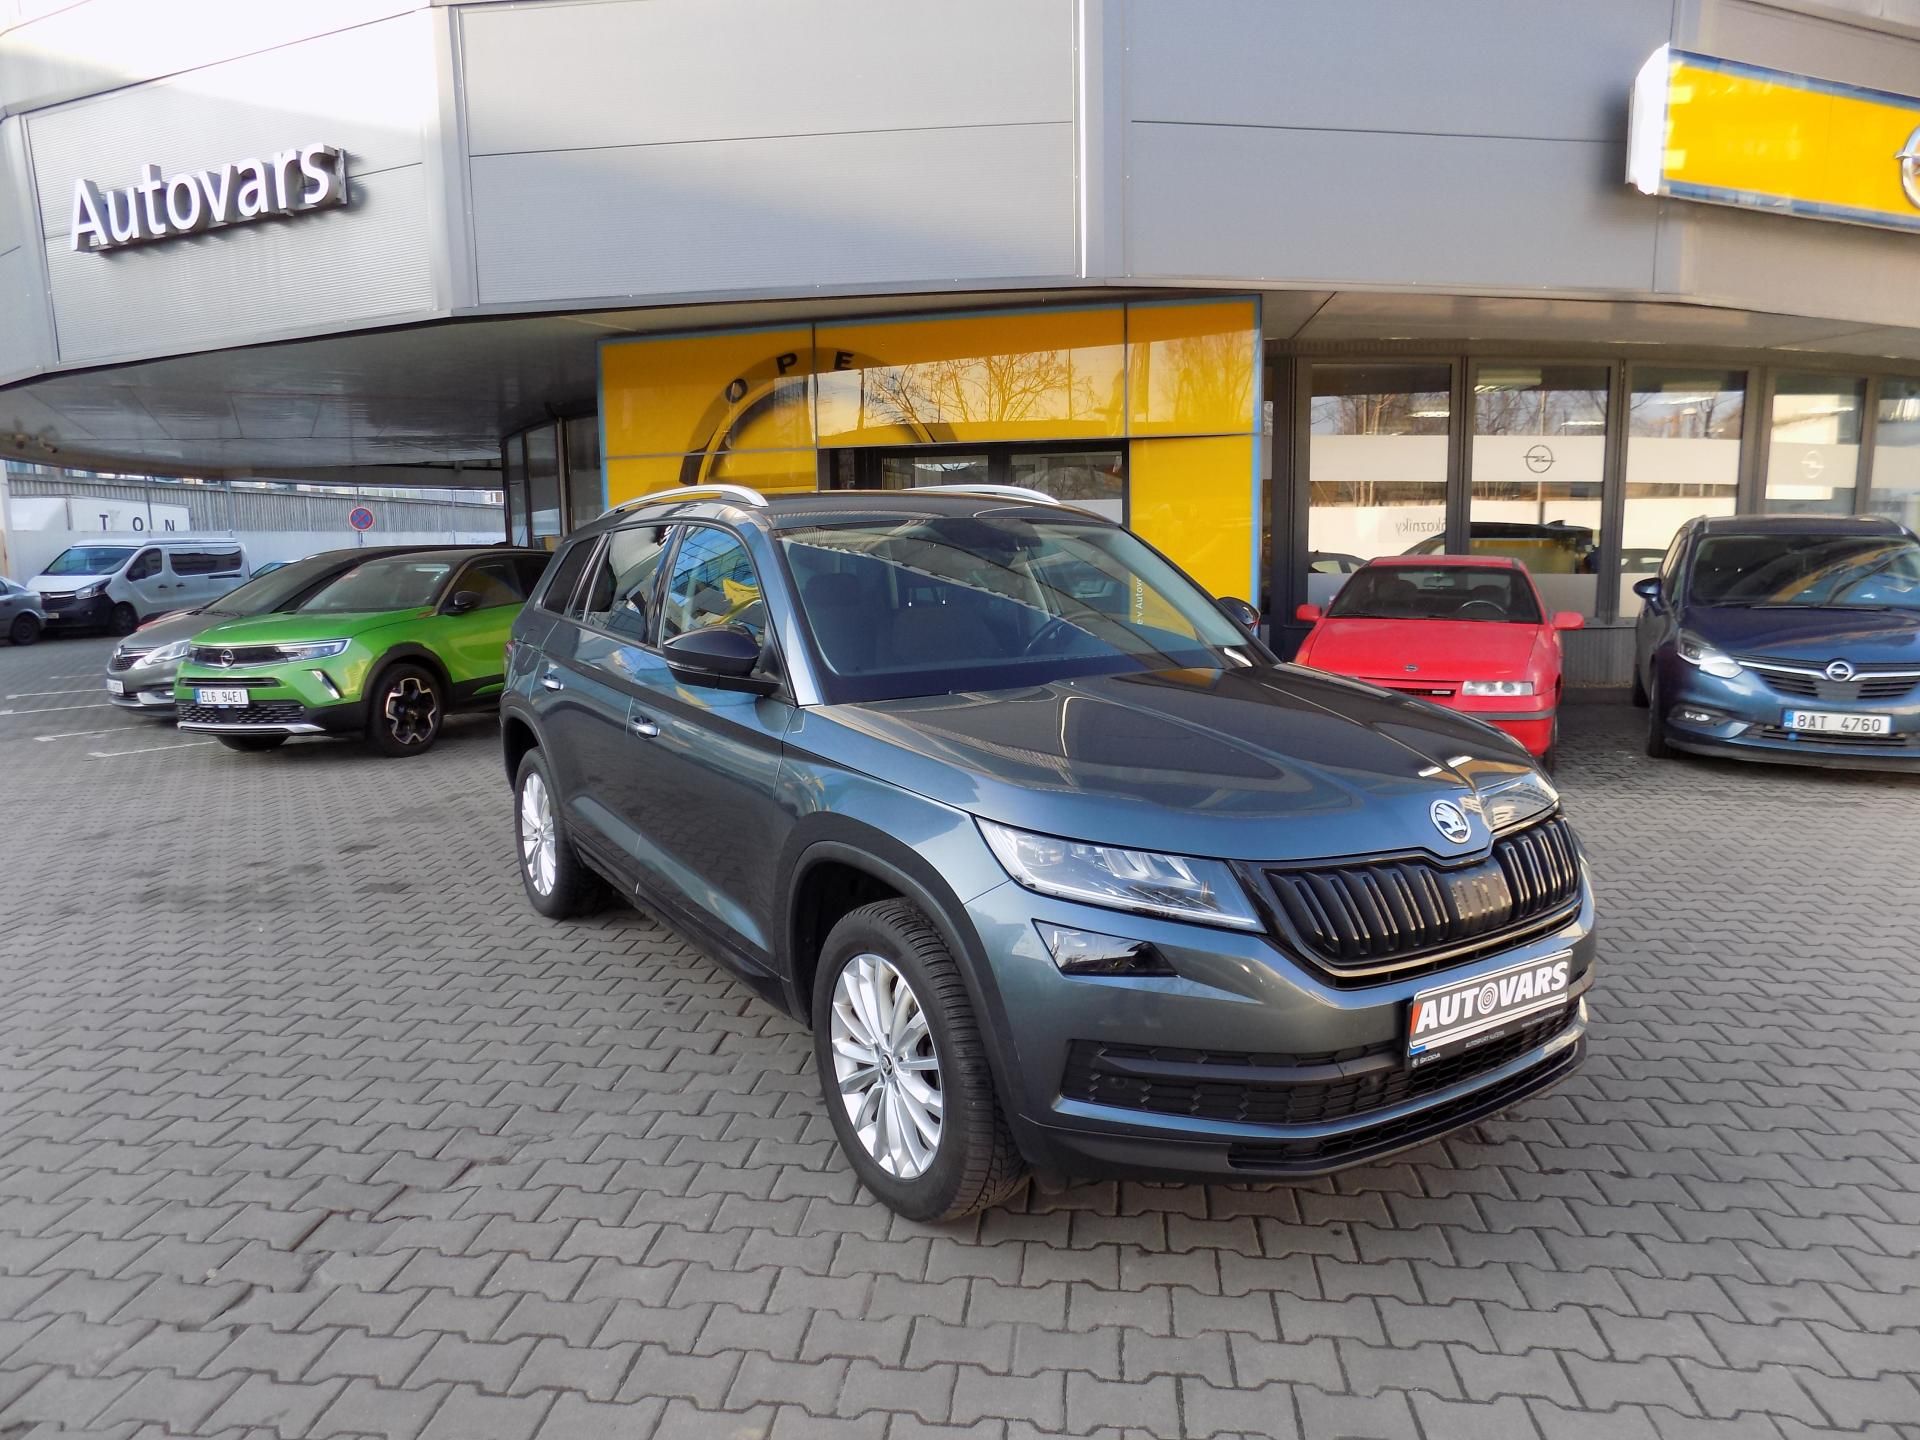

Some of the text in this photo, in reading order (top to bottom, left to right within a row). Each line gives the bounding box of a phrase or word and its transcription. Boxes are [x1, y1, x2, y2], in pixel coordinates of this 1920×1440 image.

[71, 143, 336, 251] Autovars
[725, 351, 854, 404] OPE
[1797, 714, 1881, 732] 8AT 4760
[1415, 961, 1569, 1034] AUTOVARS
